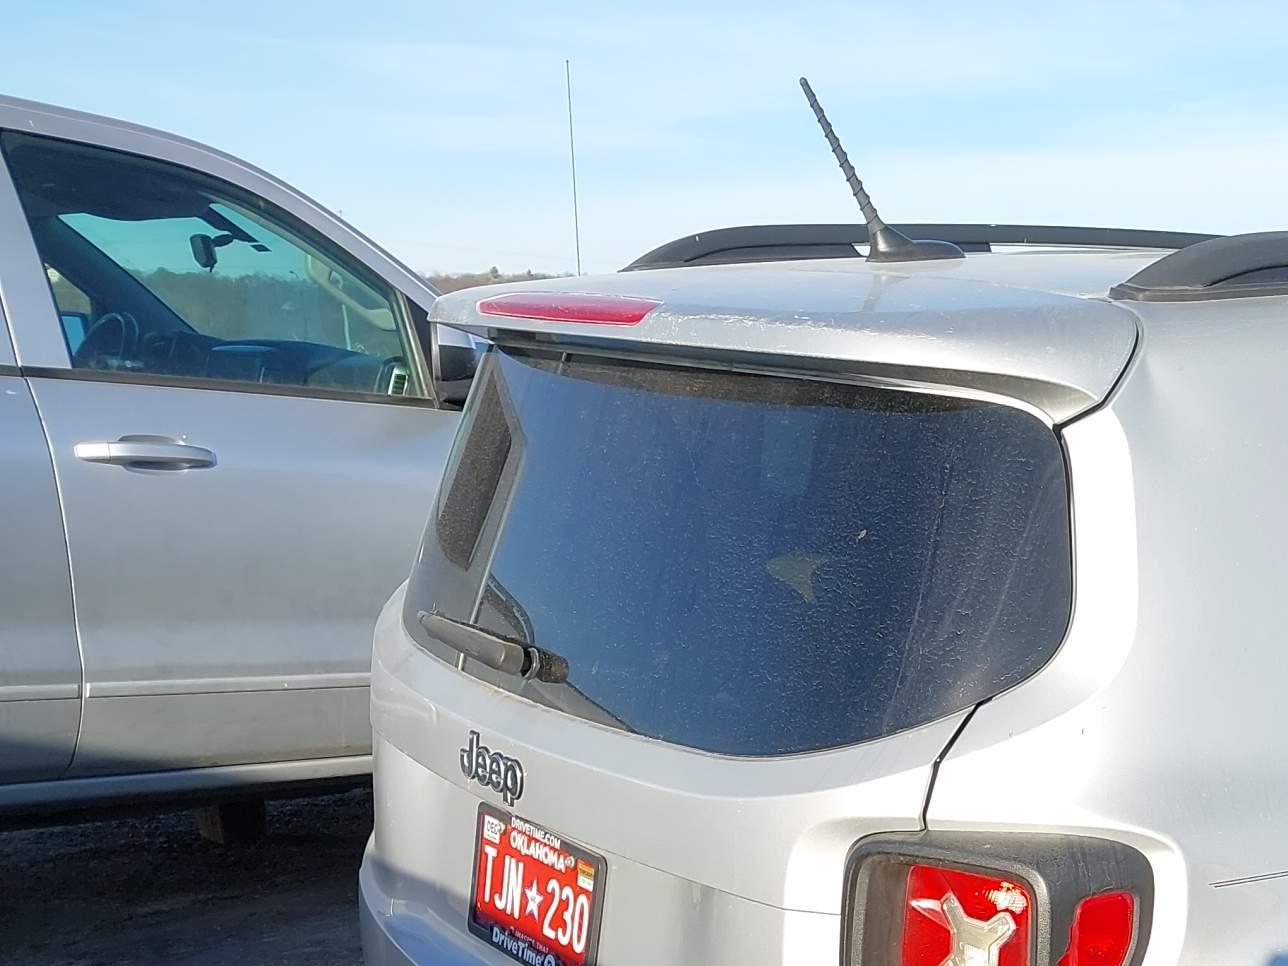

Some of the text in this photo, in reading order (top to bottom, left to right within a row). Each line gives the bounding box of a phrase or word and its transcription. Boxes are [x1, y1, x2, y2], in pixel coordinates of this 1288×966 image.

[460, 730, 524, 807] Jeep
[510, 816, 561, 850] DRIVETIME.COM
[510, 831, 567, 874] OKLAHOMA
